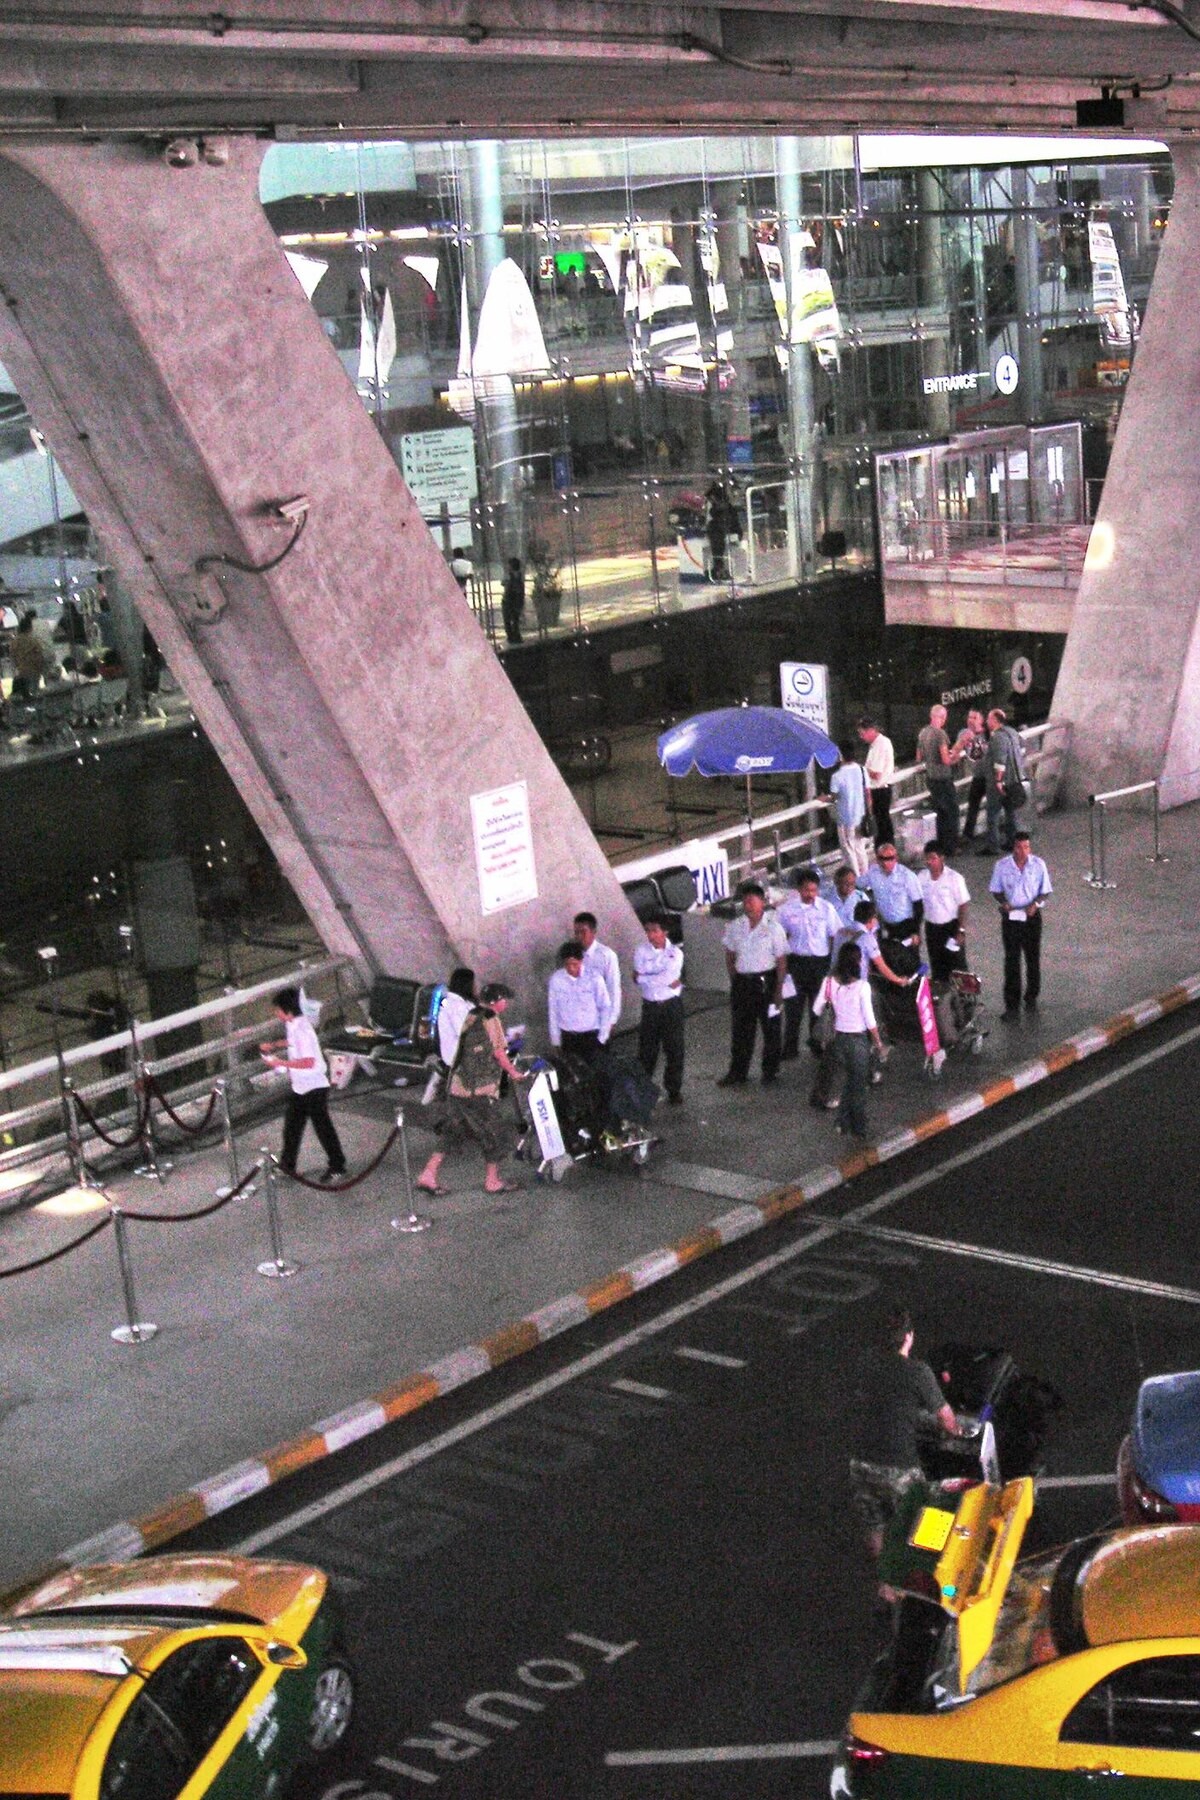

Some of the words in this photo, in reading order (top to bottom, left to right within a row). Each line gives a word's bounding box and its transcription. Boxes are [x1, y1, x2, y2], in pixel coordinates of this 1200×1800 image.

[923, 373, 977, 394] ENTRANCE
[1003, 365, 1012, 385] 4
[941, 679, 992, 705] ENTRANCE
[1018, 664, 1026, 685] 4
[690, 861, 725, 906] TAXI
